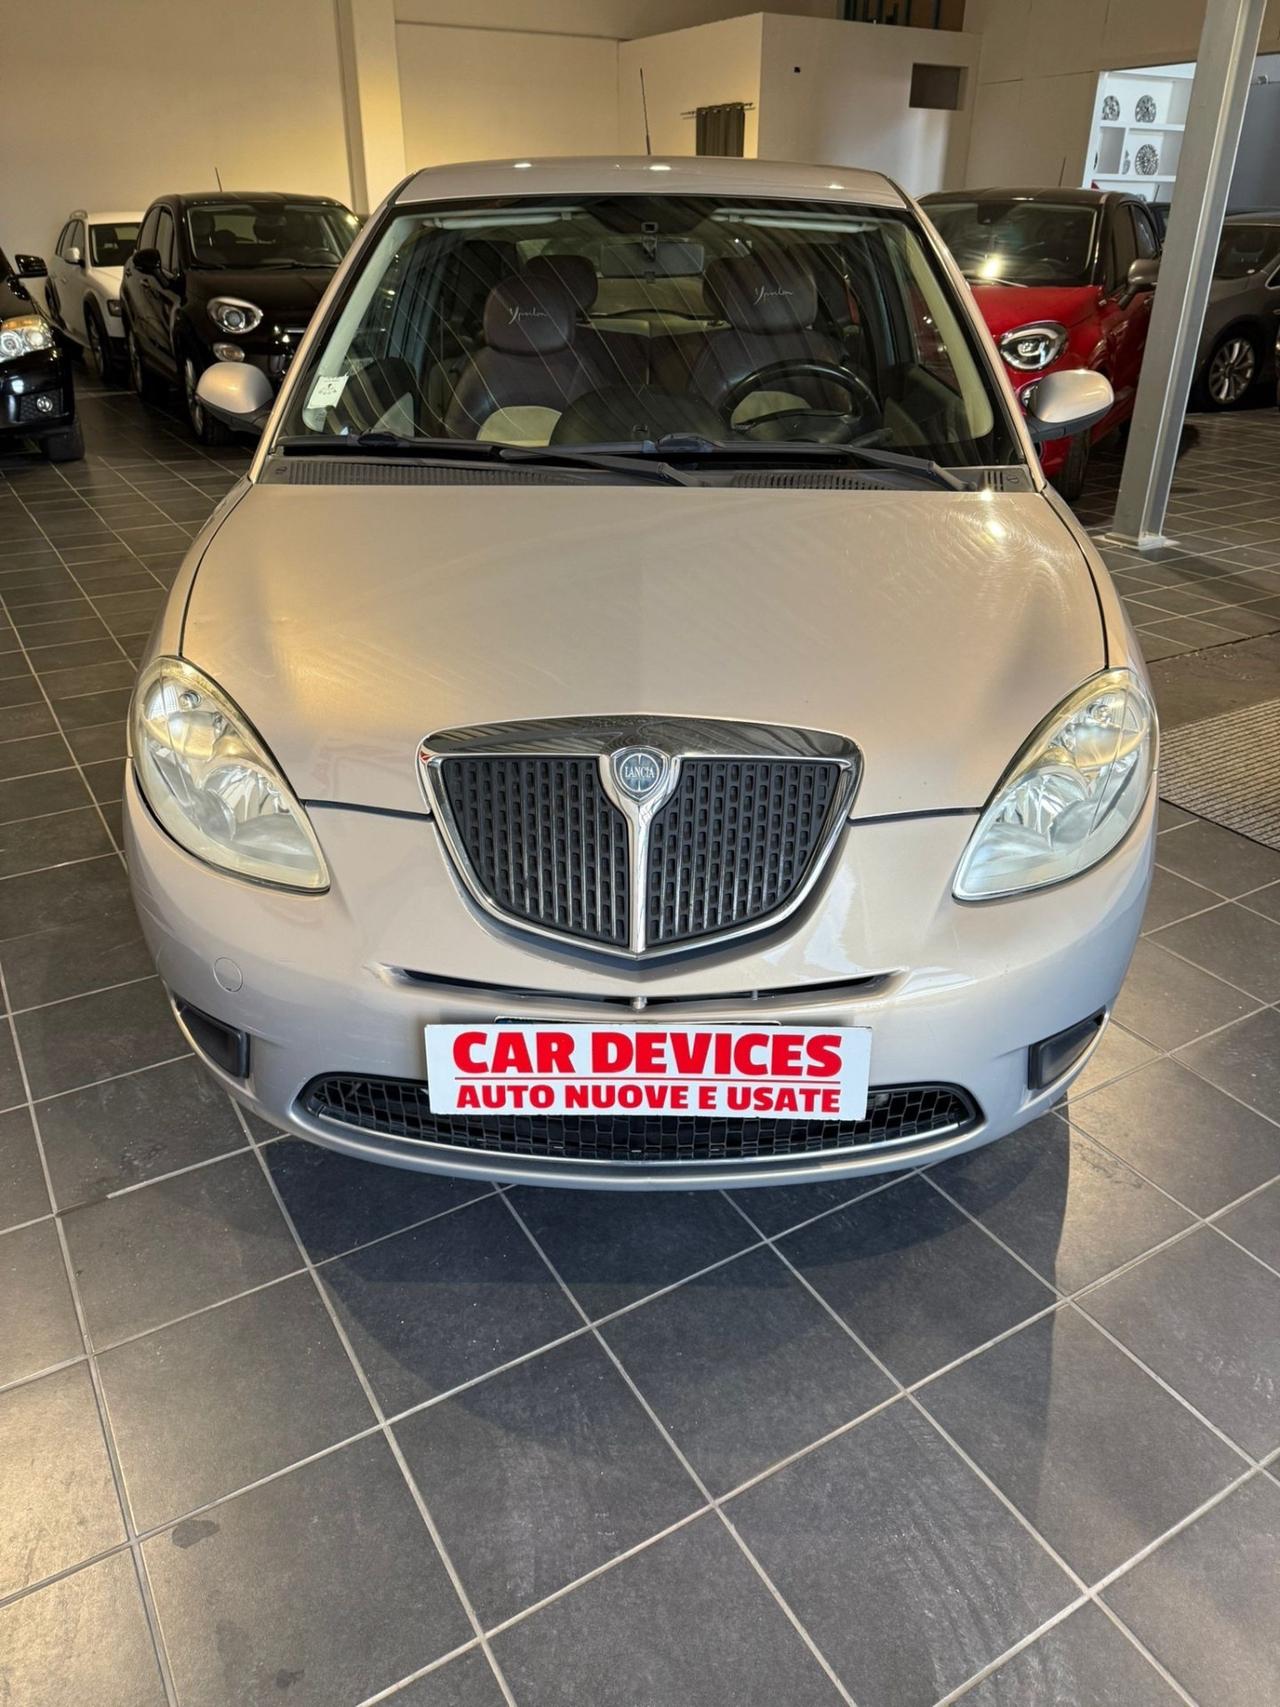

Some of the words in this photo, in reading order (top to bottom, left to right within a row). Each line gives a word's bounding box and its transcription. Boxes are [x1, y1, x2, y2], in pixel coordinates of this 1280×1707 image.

[624, 766, 655, 778] LANCIA
[452, 1031, 575, 1074] CAR
[591, 1032, 842, 1078] DEVICES
[456, 1085, 555, 1109] AUTO
[565, 1085, 689, 1110] NUOVE
[698, 1086, 717, 1110] E
[727, 1086, 841, 1113] USATE
